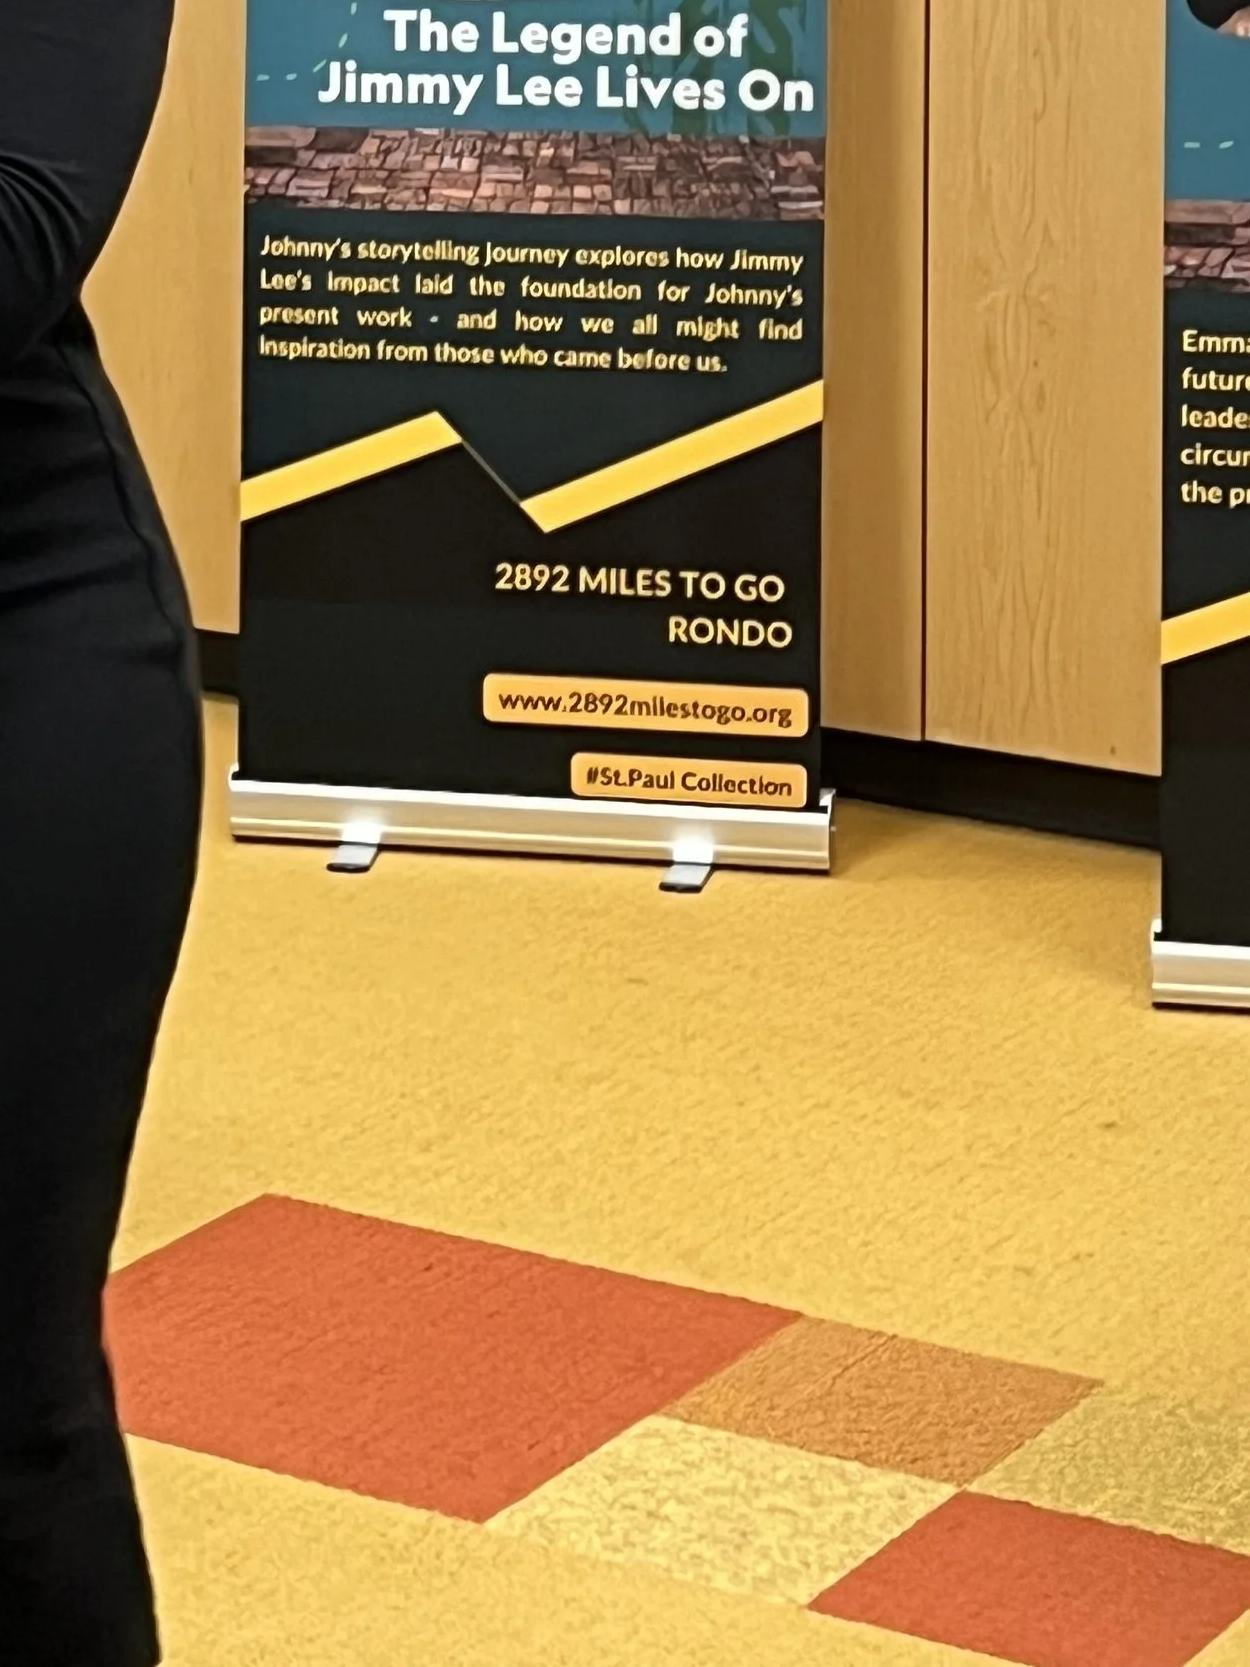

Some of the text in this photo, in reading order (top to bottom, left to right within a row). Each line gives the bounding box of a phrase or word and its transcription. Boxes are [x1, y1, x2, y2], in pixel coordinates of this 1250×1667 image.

[383, 9, 749, 64] The Legend of
[318, 60, 814, 116] Jimmy Lee Lives On
[260, 234, 804, 276] Johnny's storytelling journey explores how Jimmy
[260, 267, 804, 309] Lee's impact laid the foundation for Johnny's
[259, 306, 339, 326] present
[357, 306, 413, 328] work
[456, 308, 497, 330] and
[515, 310, 563, 332] how
[581, 317, 614, 334] we
[632, 313, 658, 335] all
[676, 314, 739, 342] might
[758, 318, 803, 340] find
[259, 334, 728, 372] inspiration from those who came before us.
[1181, 404, 1250, 430] leade
[1181, 480, 1223, 504] the
[495, 562, 785, 603] 2892 MILES TO GO
[668, 616, 793, 648] RONDO
[498, 690, 794, 729] www.2892milestogo.org
[681, 771, 793, 798] Collection
